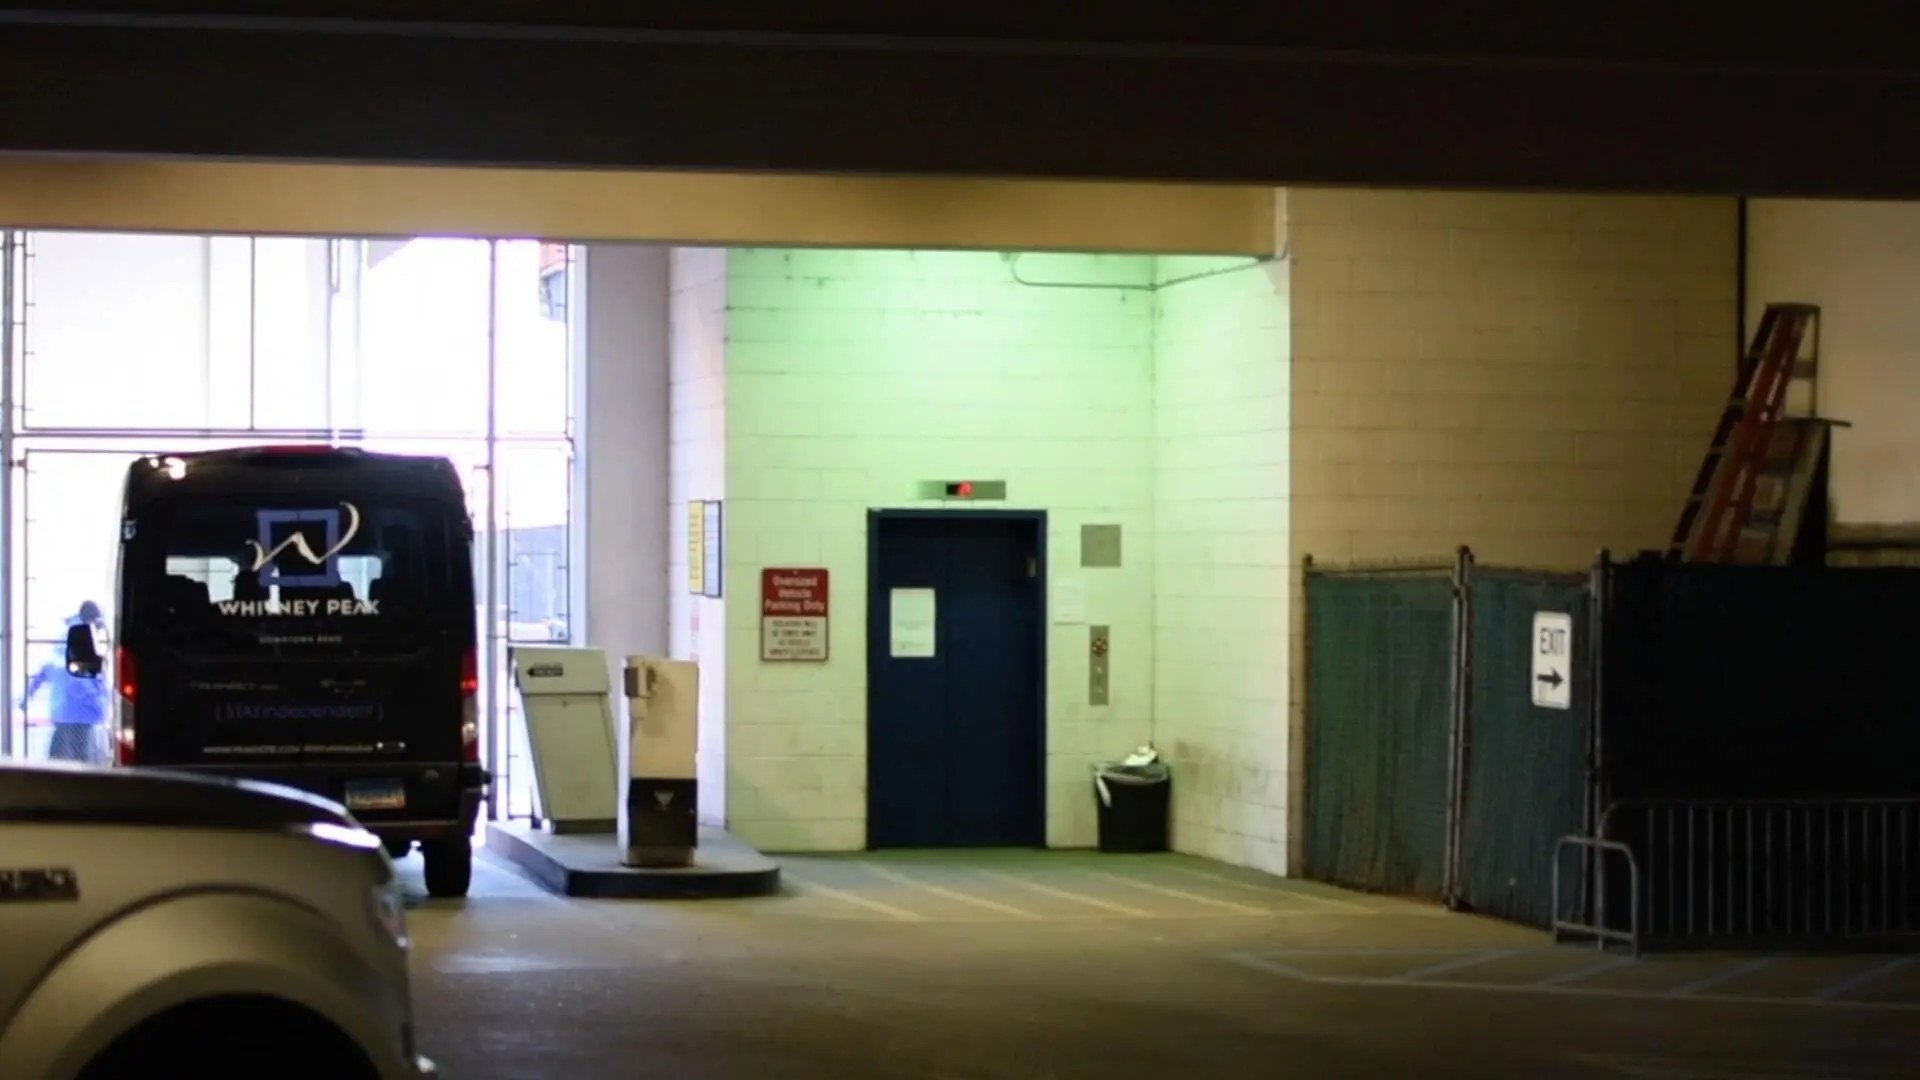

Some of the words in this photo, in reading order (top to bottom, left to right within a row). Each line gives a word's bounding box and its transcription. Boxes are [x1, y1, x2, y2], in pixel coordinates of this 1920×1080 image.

[219, 599, 319, 616] WHINEY
[326, 599, 380, 616] PEAK
[1540, 627, 1566, 655] EXIT
